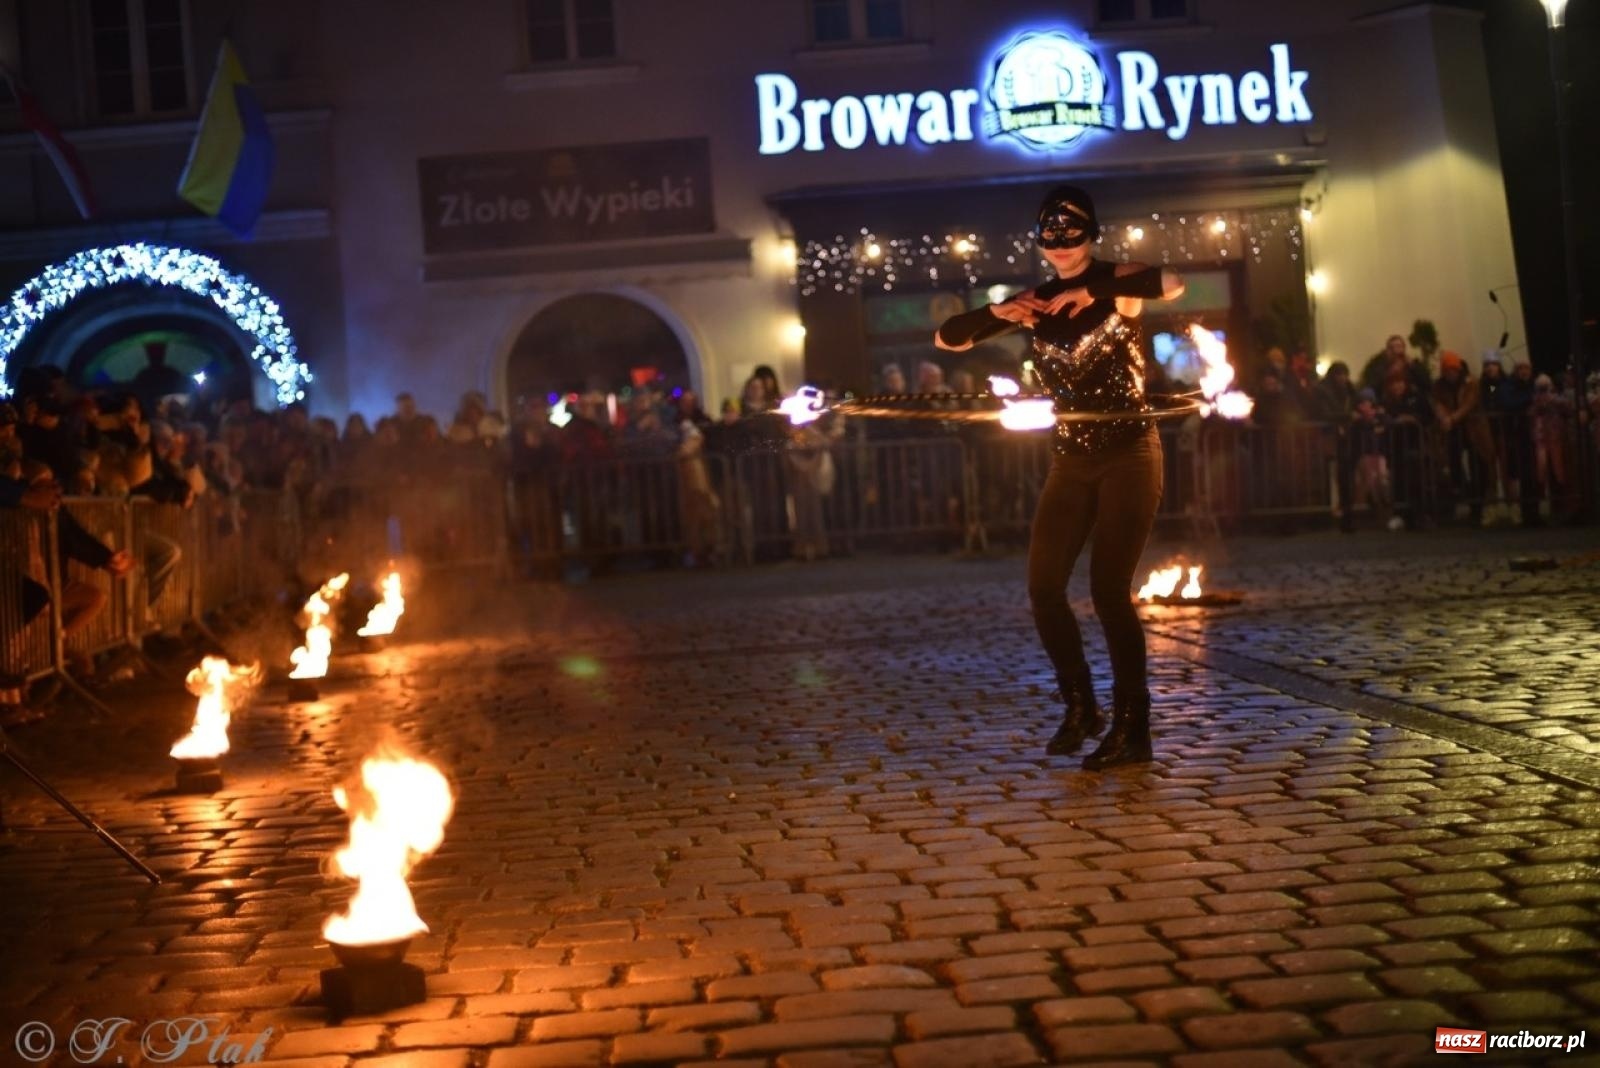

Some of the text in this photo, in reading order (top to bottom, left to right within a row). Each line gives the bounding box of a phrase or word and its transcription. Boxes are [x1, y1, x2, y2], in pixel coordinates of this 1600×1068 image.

[755, 44, 1313, 155] Browar Rynek
[438, 176, 695, 227] Złote Wypieki
